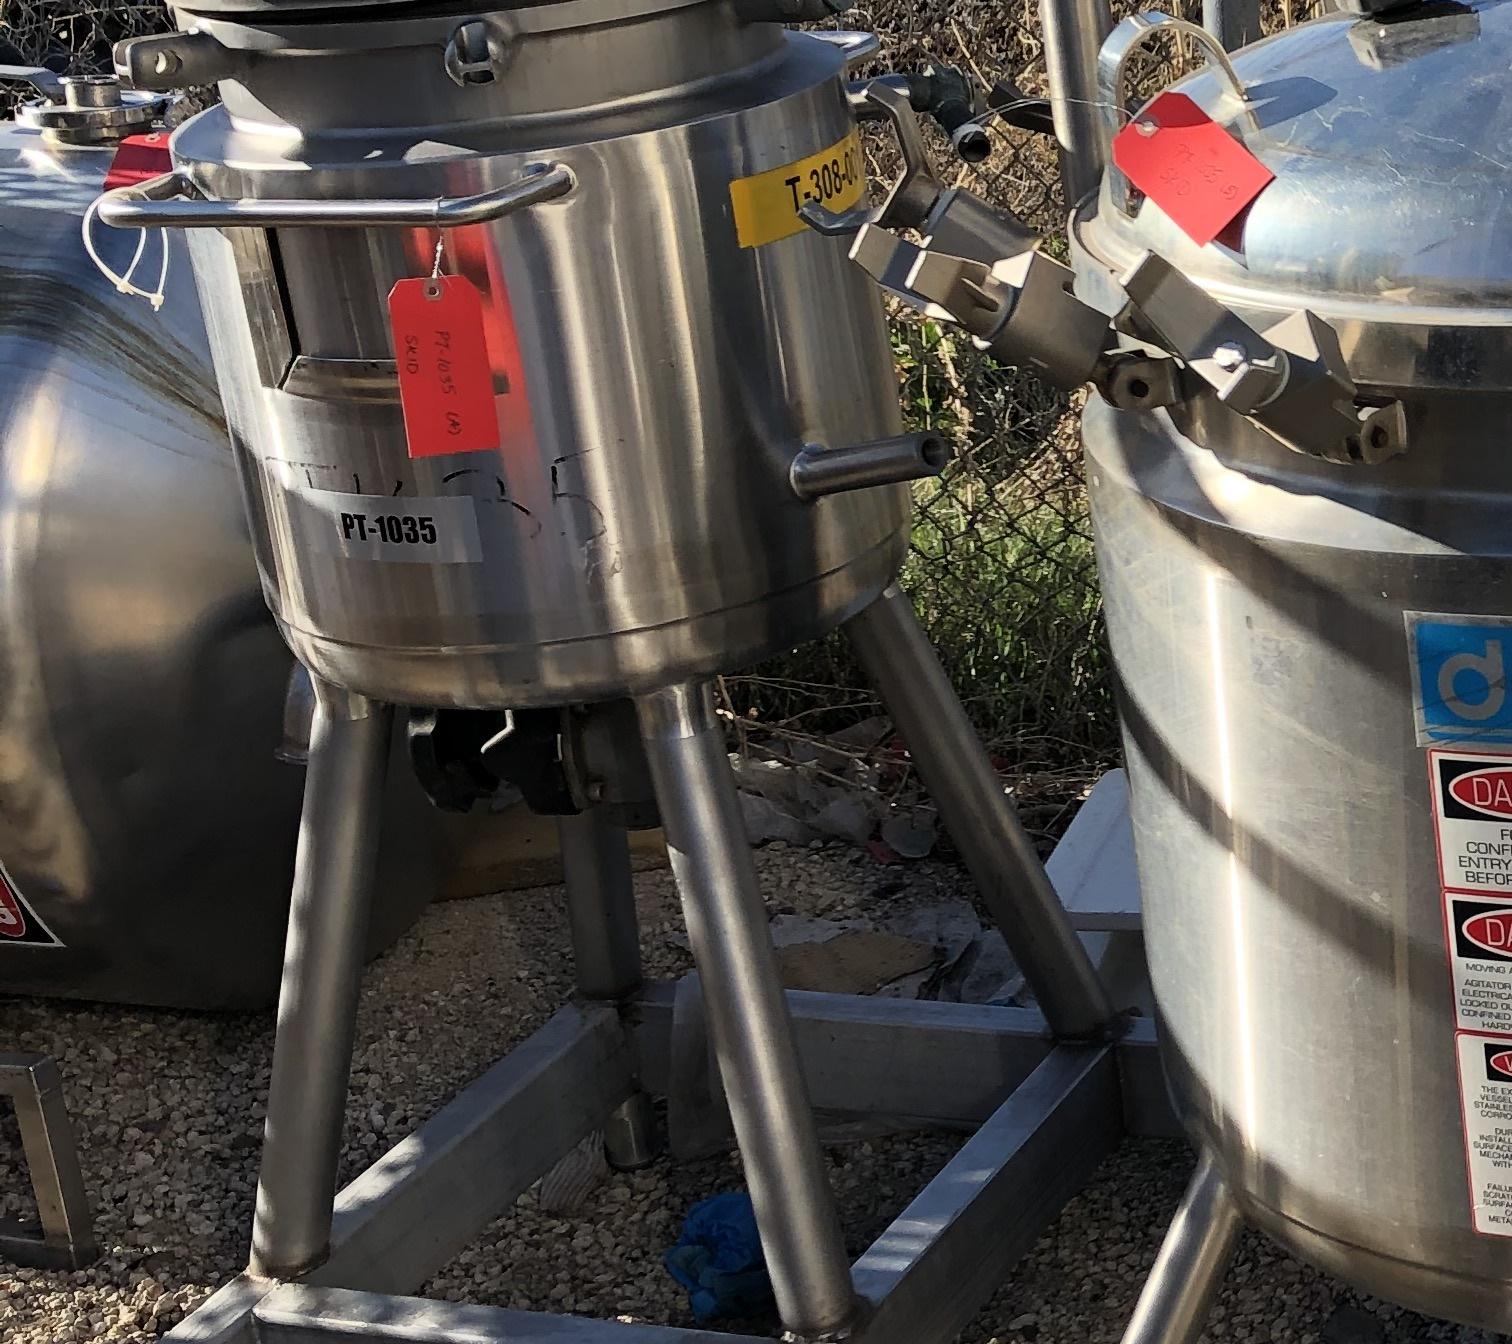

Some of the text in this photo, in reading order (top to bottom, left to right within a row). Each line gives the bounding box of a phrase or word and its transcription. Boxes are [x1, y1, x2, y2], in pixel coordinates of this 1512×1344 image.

[340, 511, 438, 545] PT-1035
[1458, 856, 1512, 871] ENTRY
[1465, 963, 1506, 974] MOVING
[1464, 979, 1511, 990] AGITATOR
[1459, 999, 1498, 1010] LOCKED
[1461, 1009, 1511, 1020] CONFINED
[1481, 1086, 1498, 1094] THE
